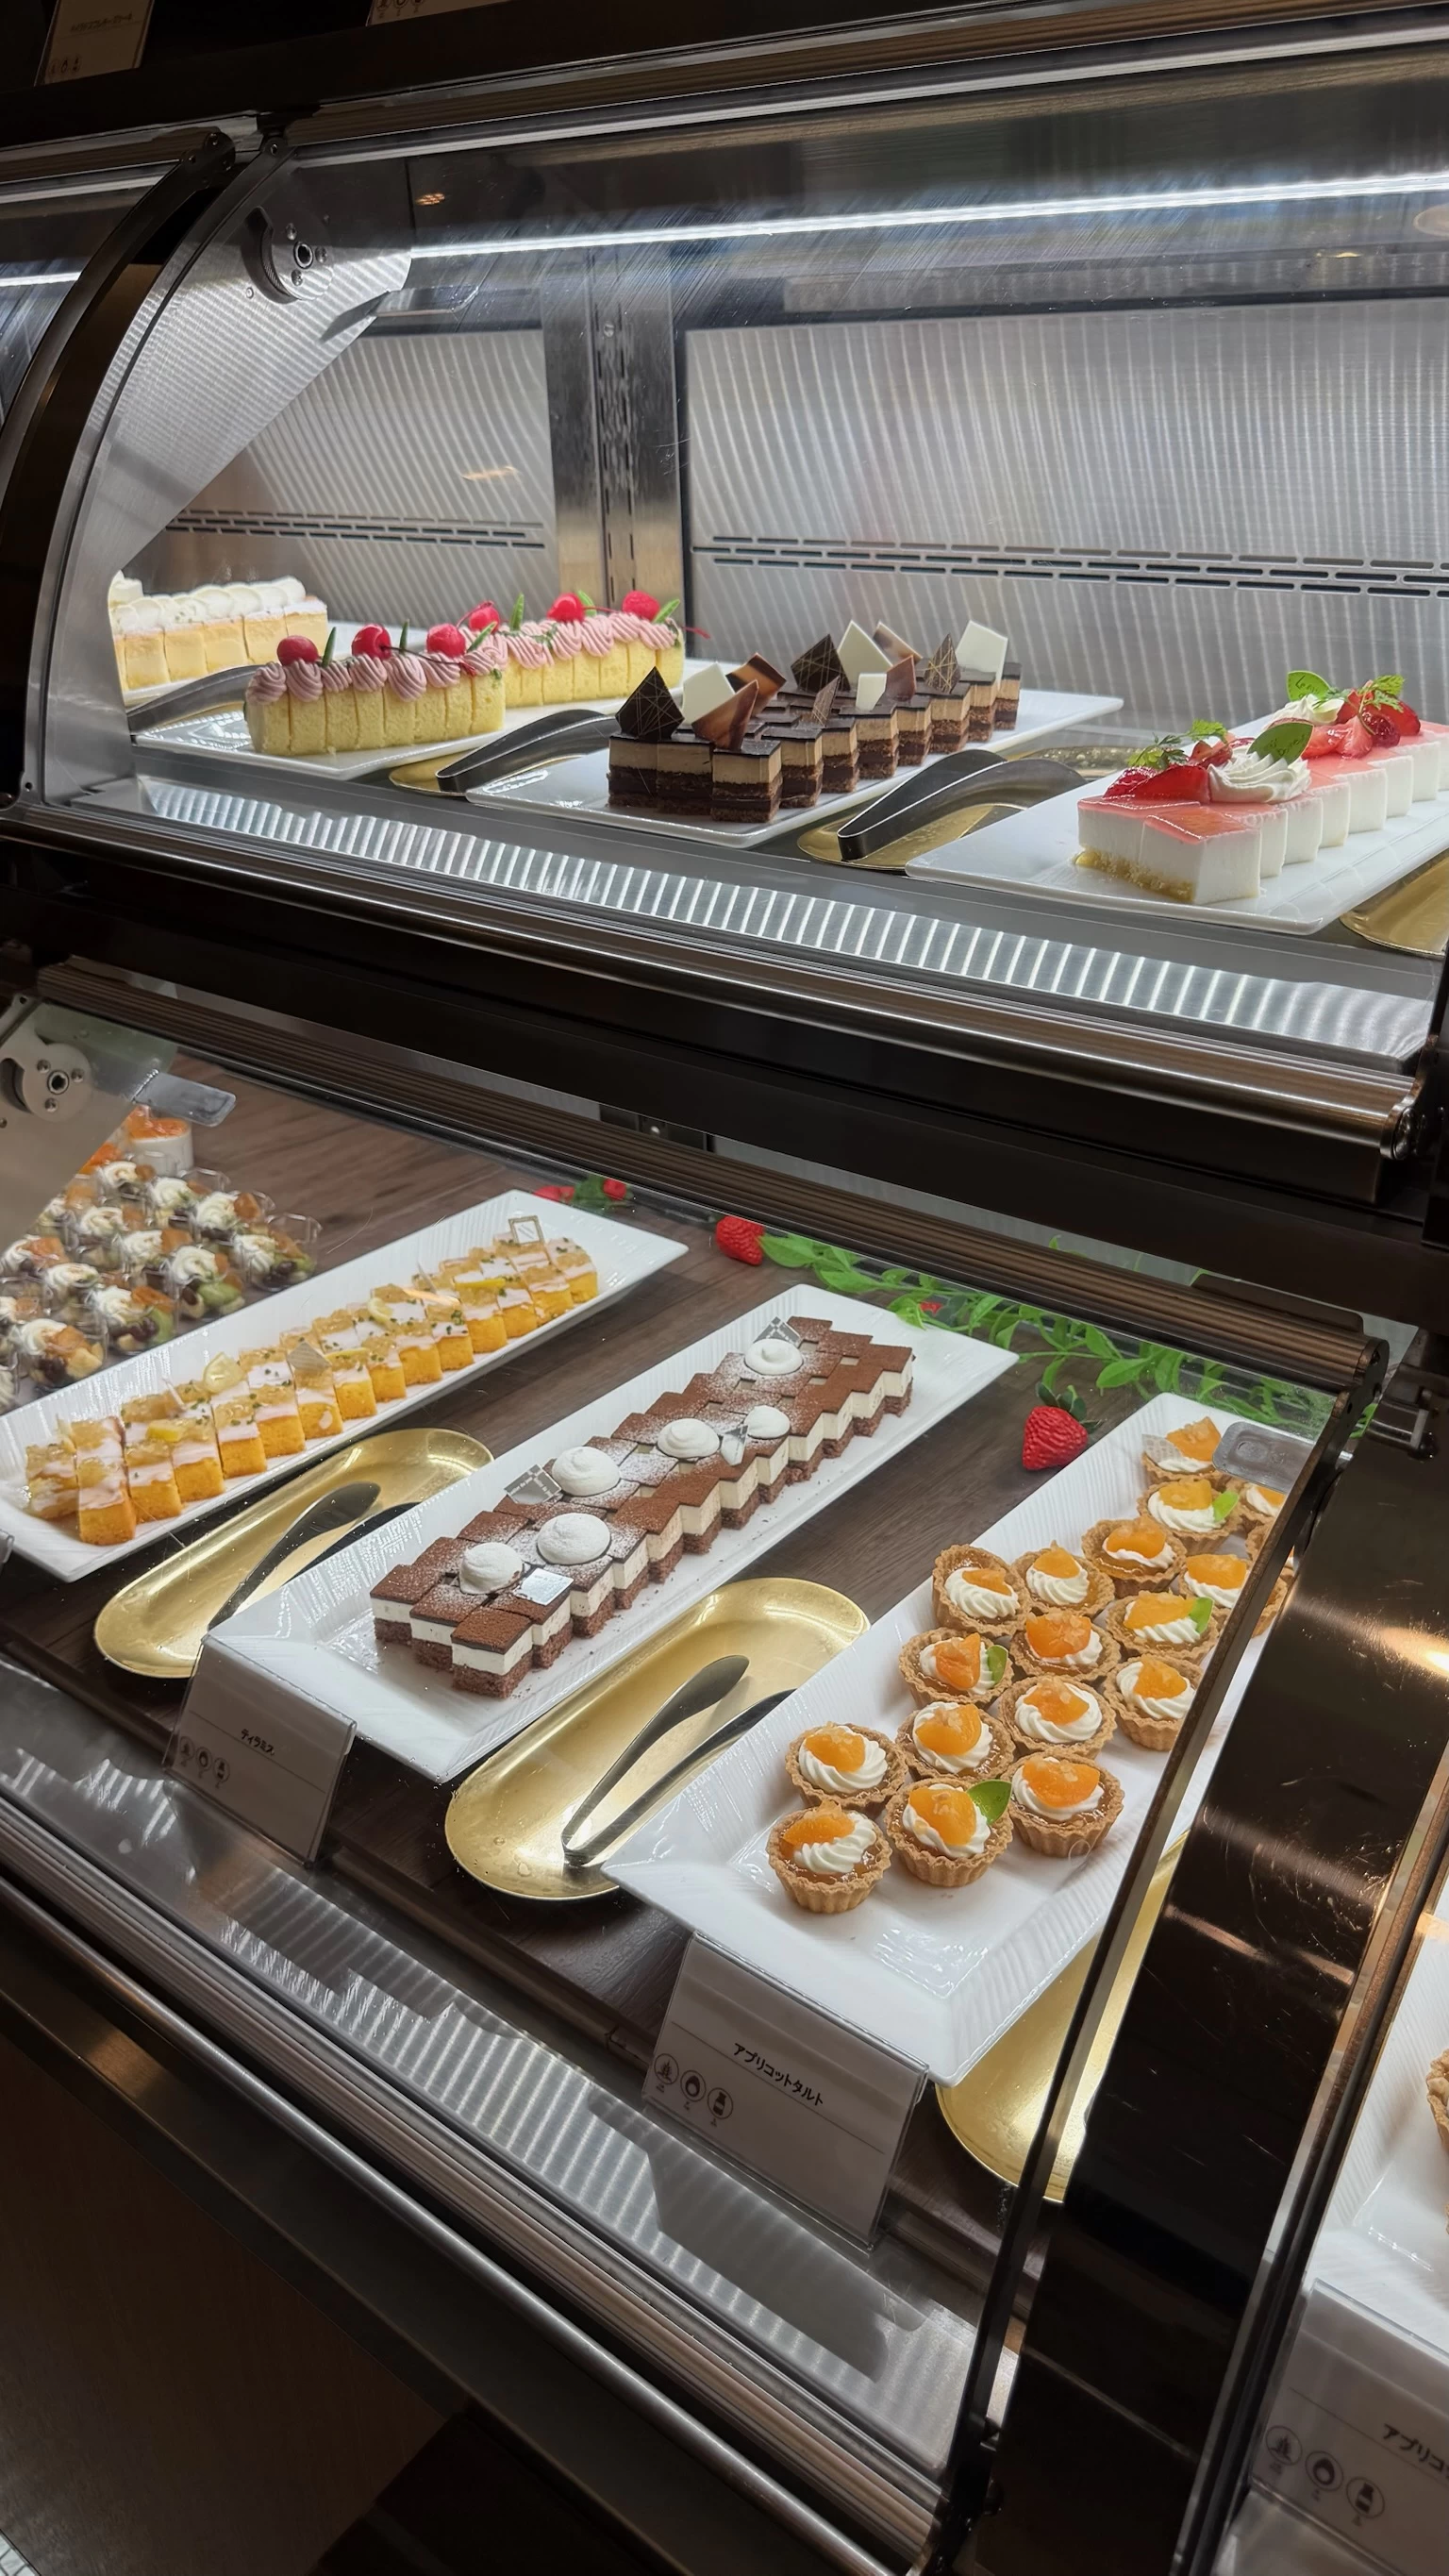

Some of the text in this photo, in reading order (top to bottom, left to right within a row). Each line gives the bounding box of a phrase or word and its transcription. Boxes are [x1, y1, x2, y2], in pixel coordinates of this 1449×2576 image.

[241, 1728, 275, 1756] ティラミス
[732, 2042, 824, 2107] アプリコットタルト
[1382, 2422, 1449, 2483] アプリコ
